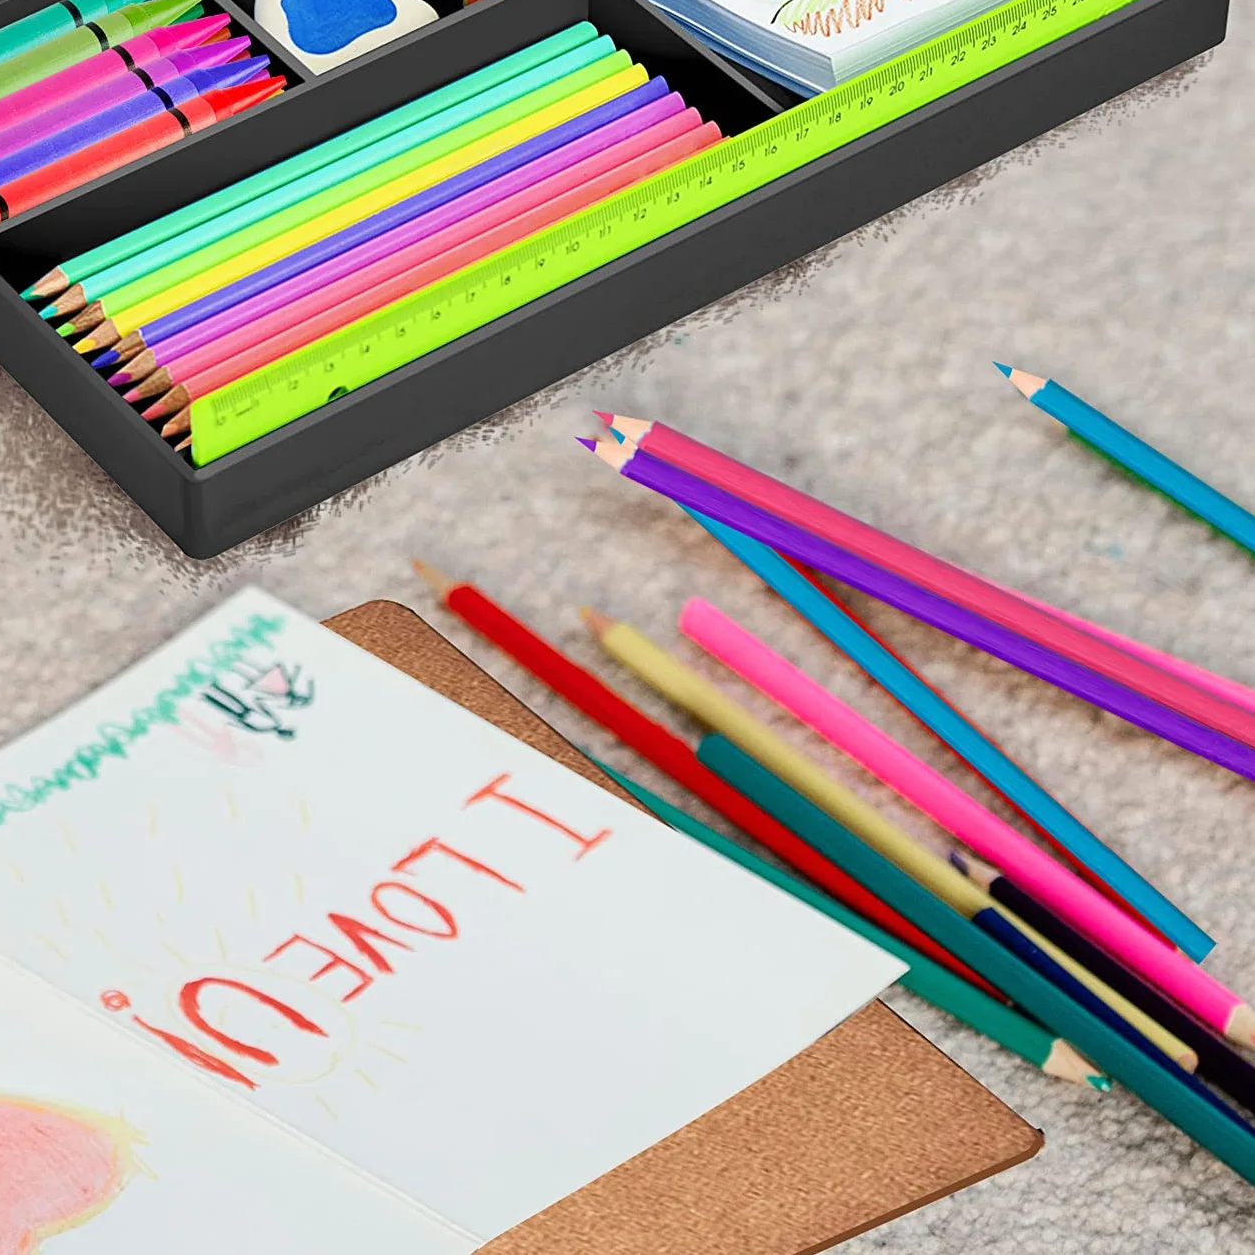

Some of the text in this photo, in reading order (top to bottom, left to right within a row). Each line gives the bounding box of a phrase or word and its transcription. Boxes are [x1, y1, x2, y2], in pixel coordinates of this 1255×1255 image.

[565, 241, 580, 255] 10
[599, 225, 612, 239] 11
[633, 208, 647, 222] 12
[666, 192, 680, 206] 13
[699, 176, 713, 189] 14
[732, 160, 746, 173] 15
[764, 145, 778, 157] 16
[796, 128, 809, 141] 17
[828, 112, 842, 126] 18
[860, 96, 874, 110] 19
[889, 81, 905, 96] 20
[919, 67, 933, 81] 21
[951, 51, 966, 66] 22
[981, 36, 997, 51] 23
[1011, 21, 1027, 36] 24
[1042, 7, 1057, 21] 25
[100, 771, 614, 1092] I LOVE U!
